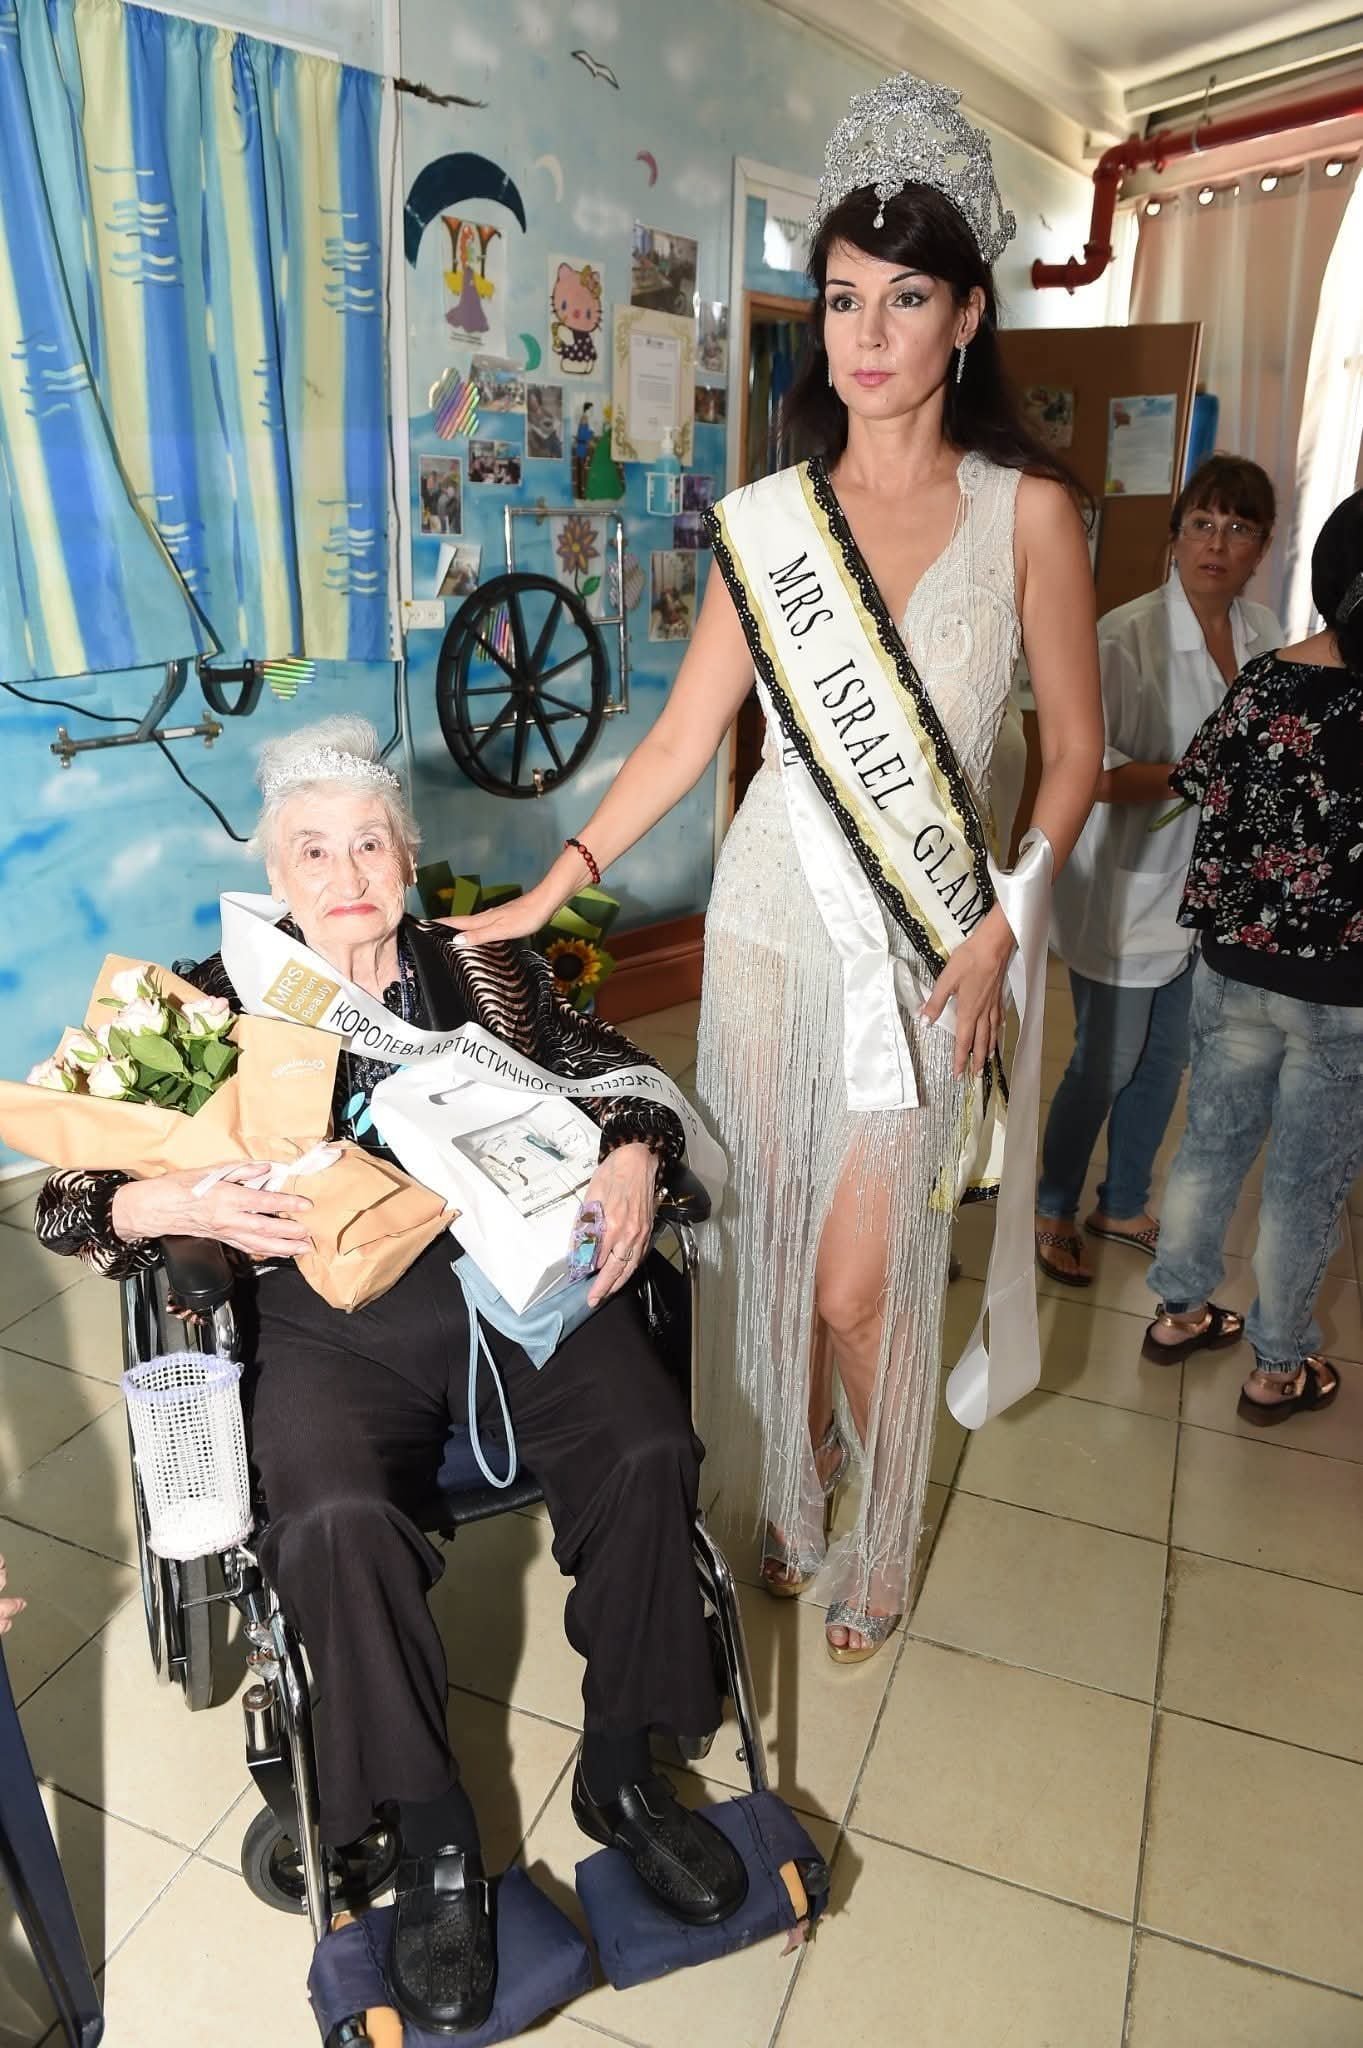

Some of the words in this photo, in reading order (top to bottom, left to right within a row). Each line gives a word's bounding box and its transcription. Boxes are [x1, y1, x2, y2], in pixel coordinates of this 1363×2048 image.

[768, 551, 833, 651] MRS.
[813, 658, 915, 811] ISRAEL
[913, 824, 986, 938] GLAM
[270, 966, 304, 1006] MRS
[288, 976, 319, 1012] Golden
[303, 984, 333, 1019] Beauty
[330, 1001, 424, 1056] КОРОЛЕВА
[427, 1036, 580, 1093] АРТИСТИЧНОСТИ
